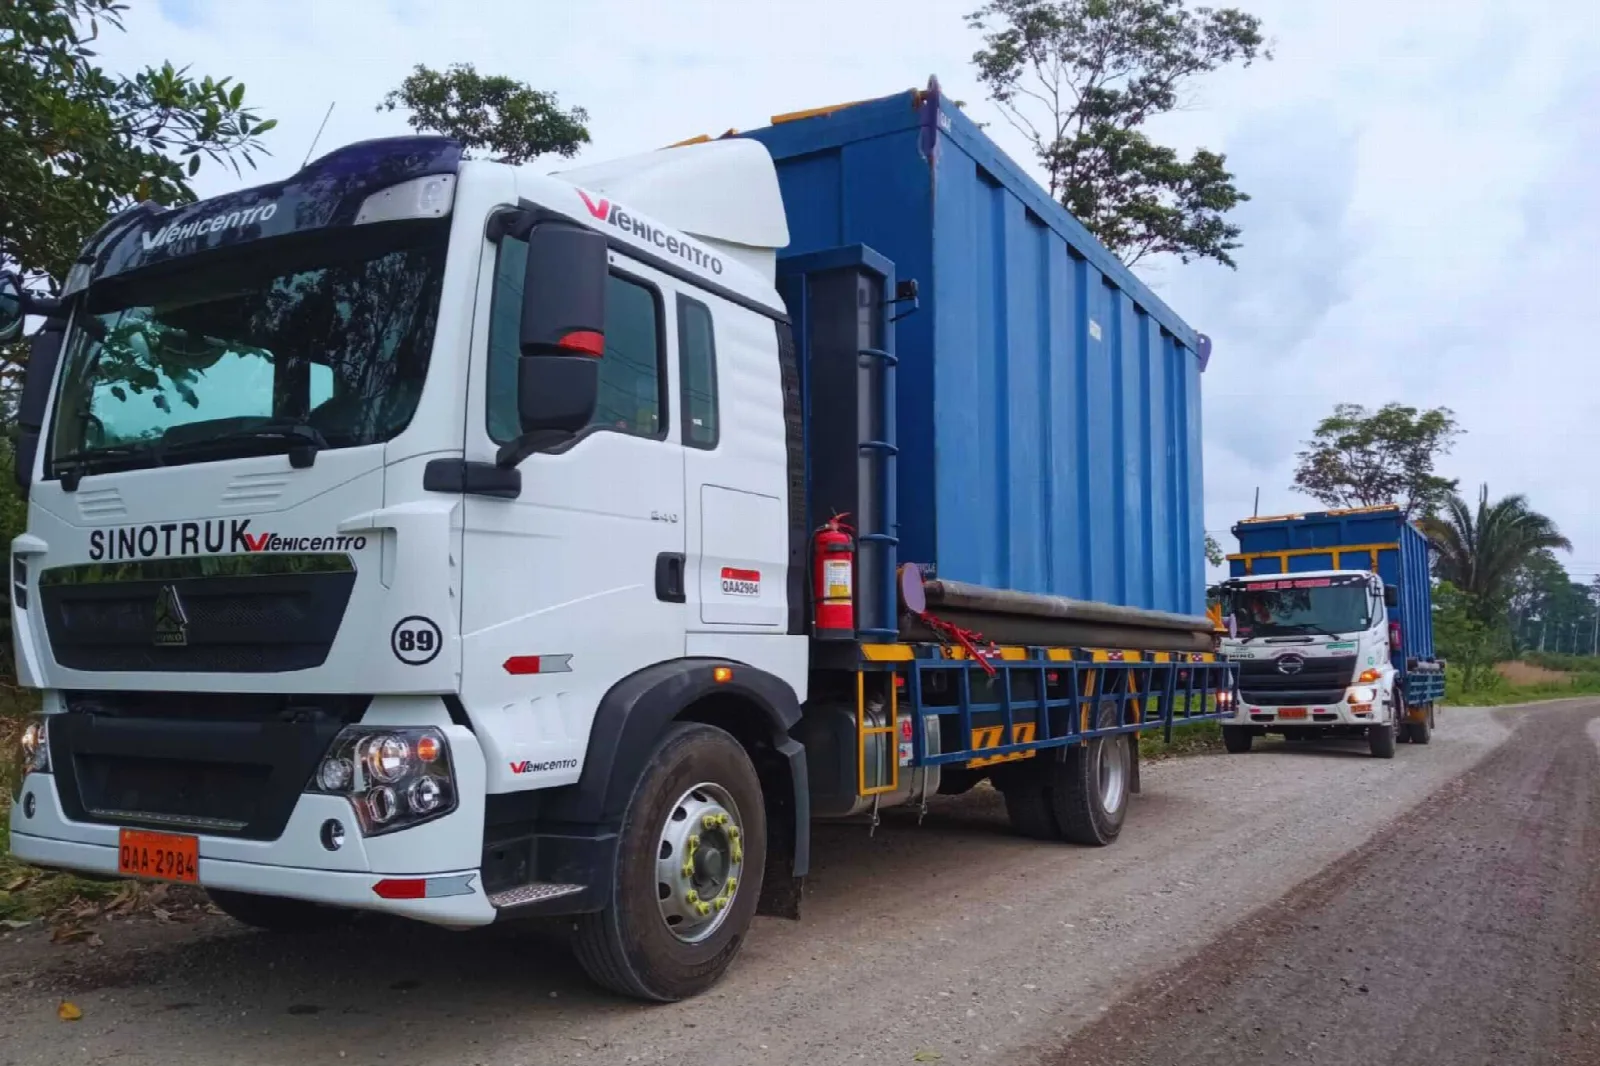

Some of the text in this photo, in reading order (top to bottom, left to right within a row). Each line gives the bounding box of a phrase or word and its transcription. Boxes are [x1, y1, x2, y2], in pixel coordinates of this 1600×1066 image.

[89, 519, 251, 560] SINOTRUK
[722, 580, 759, 594] QAA2984
[399, 630, 433, 651] 89
[122, 845, 194, 876] QAA-2984
